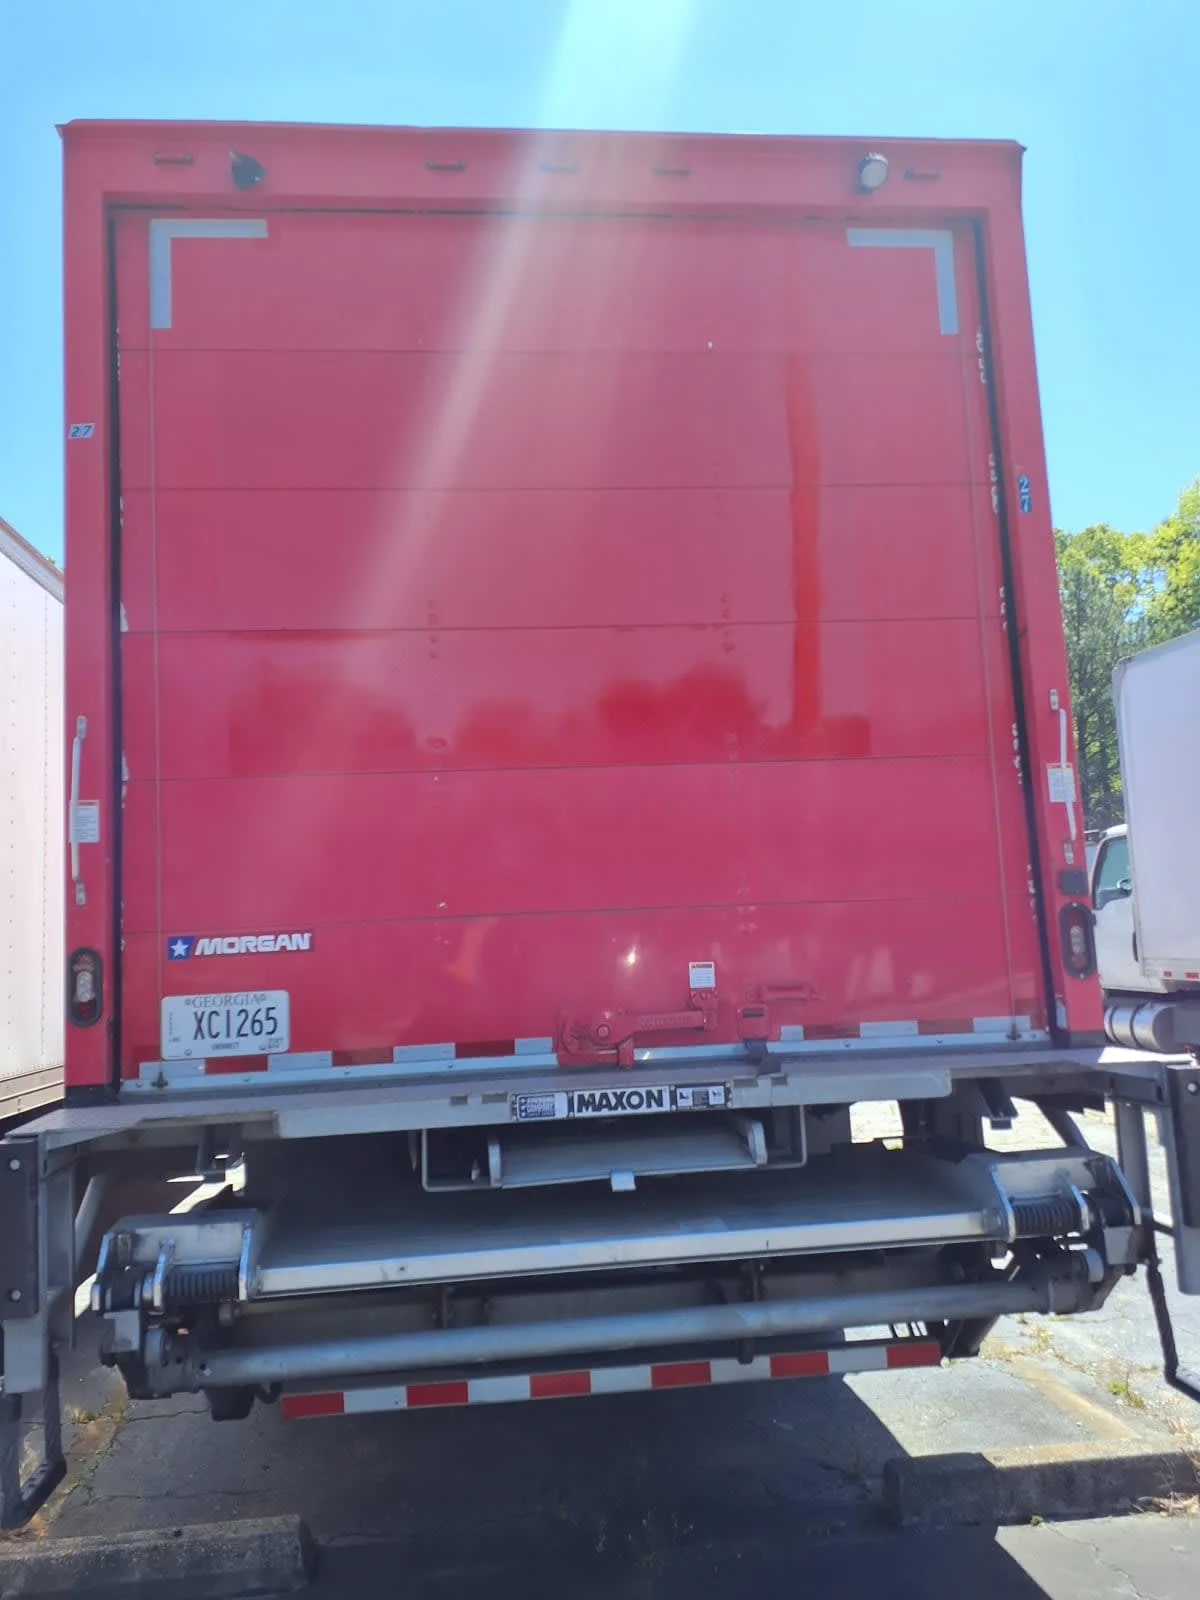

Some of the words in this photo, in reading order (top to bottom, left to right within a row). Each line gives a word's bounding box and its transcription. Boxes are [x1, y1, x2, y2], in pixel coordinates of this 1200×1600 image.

[71, 424, 93, 438] 27
[195, 933, 311, 956] MORGAN
[192, 993, 262, 1008] GEORGIA
[577, 1089, 663, 1112] MAXON
